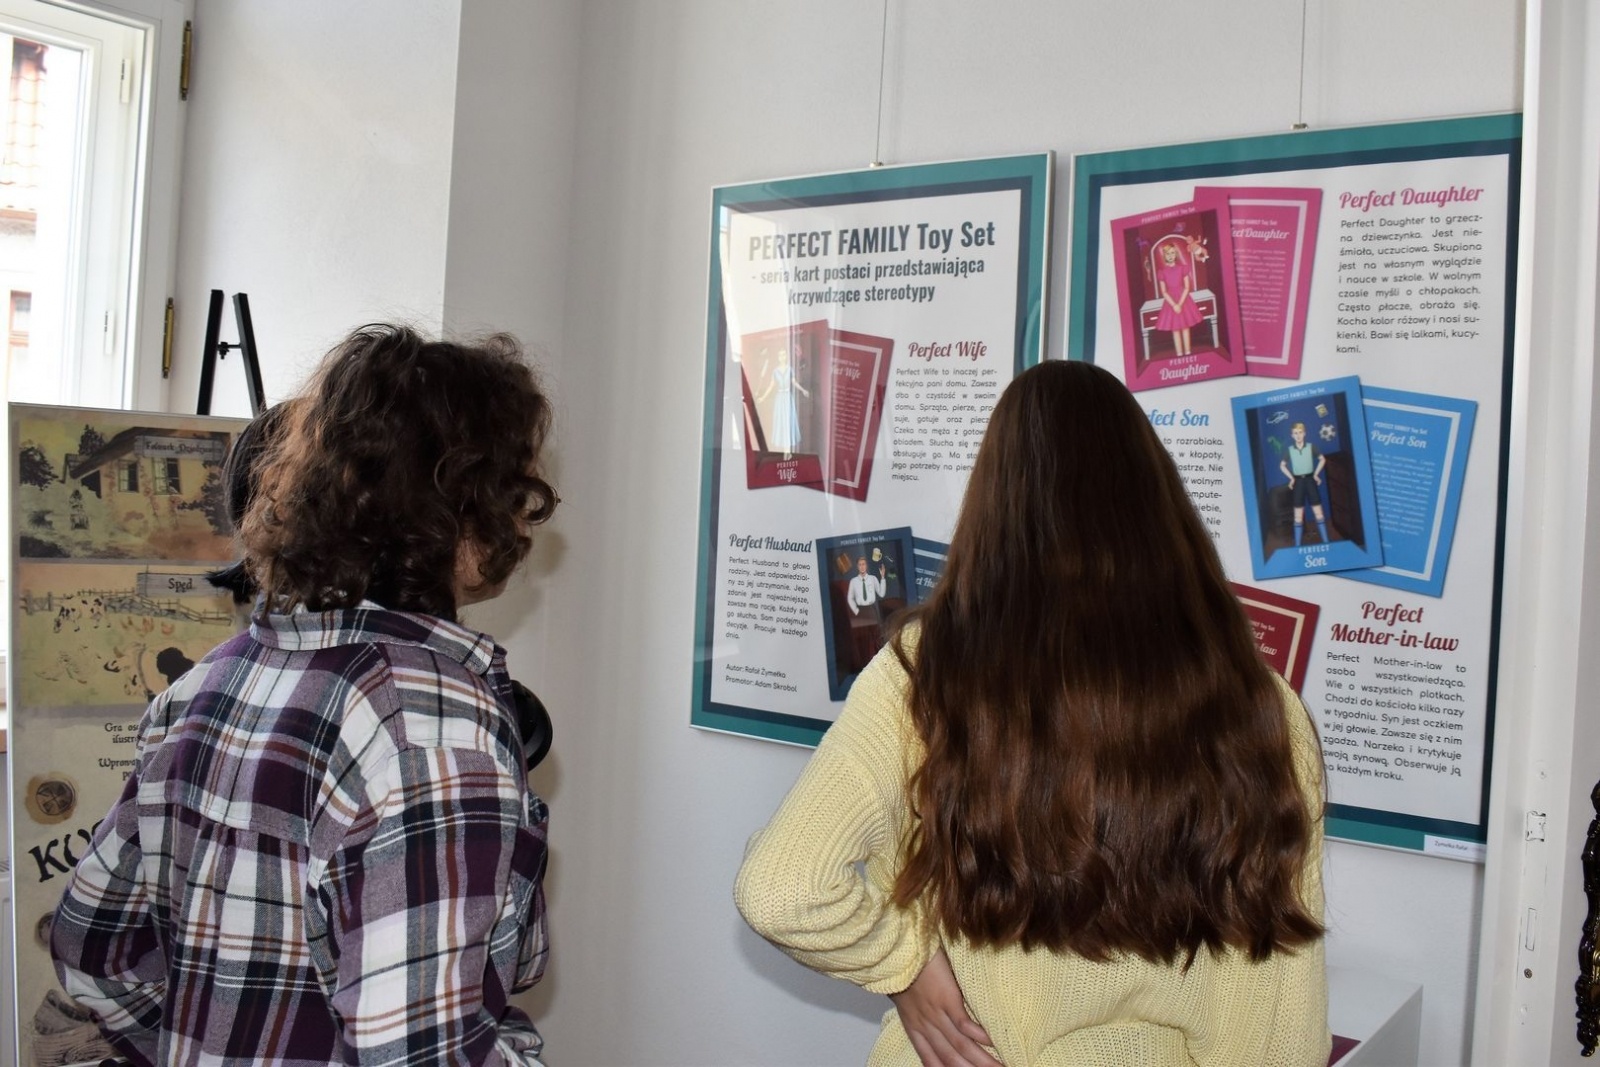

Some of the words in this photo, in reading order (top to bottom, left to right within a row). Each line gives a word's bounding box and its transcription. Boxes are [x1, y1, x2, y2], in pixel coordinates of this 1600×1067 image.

[1340, 191, 1396, 212] Perfect
[1401, 186, 1484, 208] Daughter
[1341, 220, 1374, 228] Perfect
[1379, 217, 1426, 228] Daughter
[1446, 215, 1482, 224] grzecz-
[1245, 227, 1290, 241] Daughter
[1362, 232, 1422, 242] dziewczynka.
[1432, 229, 1453, 238] Jest
[1463, 228, 1482, 237] nie-
[749, 230, 831, 261] PERFECT
[838, 225, 911, 255] FAMILY
[917, 223, 952, 253] Toy
[961, 222, 995, 247] Set
[1340, 247, 1374, 256] śmiała,
[1378, 245, 1429, 255] uczuciowa.
[1433, 242, 1482, 253] Skupiona
[761, 269, 789, 284] seria
[794, 266, 819, 282] kart
[824, 263, 870, 283] postaci
[875, 257, 984, 280] przedstawiająca
[1338, 262, 1356, 272] jest
[1384, 260, 1424, 270] własnym
[1432, 258, 1481, 268] wyglądzie
[1393, 274, 1424, 282] szkole.
[1429, 272, 1439, 280] W
[1443, 272, 1481, 282] wolnym
[789, 287, 860, 307] krzywdzące
[865, 284, 935, 302] stereotypy
[1338, 289, 1369, 298] czasie
[1376, 288, 1399, 298] myśli
[1418, 286, 1480, 296] chłopakach.
[1338, 303, 1370, 313] Często
[1378, 303, 1412, 313] płacze,
[1420, 301, 1455, 310] obraża
[1463, 300, 1480, 310] się.
[1337, 317, 1367, 325] Kocha
[1370, 316, 1395, 325] kolor
[1397, 316, 1430, 325] różowy
[1439, 315, 1460, 323] nosi
[1337, 331, 1366, 339] kienki.
[1370, 331, 1392, 339] Bawi
[1396, 331, 1409, 340] się
[1411, 329, 1448, 339] lalkami,
[1452, 329, 1479, 339] kucy-
[909, 342, 952, 361] Perfect
[956, 341, 987, 361] Wife
[1336, 345, 1361, 353] kami.
[1169, 356, 1198, 366] PERFECT
[953, 368, 978, 377] inaczej
[1159, 364, 1210, 381] Daughter
[927, 380, 942, 388] pani
[926, 392, 956, 401] czystość
[1149, 409, 1176, 426] fect
[1180, 409, 1209, 426] Son
[1176, 438, 1224, 446] rozrabiaka.
[1370, 430, 1406, 446] Perfect
[1407, 436, 1427, 449] Son
[1190, 451, 1224, 460] kłopoty.
[777, 468, 797, 482] Wife
[1209, 464, 1223, 472] Nie
[1191, 477, 1223, 486] wolnym
[1206, 517, 1221, 525] Nie
[729, 534, 763, 551] Perfect
[765, 536, 812, 553] Husband
[1298, 545, 1330, 554] PERFECT
[729, 556, 749, 564] Perfect
[752, 559, 779, 567] Husband
[1304, 555, 1327, 568] Son
[1362, 601, 1424, 627] Perfect
[1330, 623, 1459, 651] Mother-in-law
[1327, 652, 1360, 663] Perfect
[1374, 656, 1443, 671] Mother-in-law
[1456, 664, 1467, 673] to
[755, 680, 772, 688] Adam
[1326, 667, 1356, 676] osoba
[1376, 672, 1465, 688] wszystkowiedząca.
[1325, 679, 1343, 689] Wie
[1361, 684, 1413, 696] wszystkich
[1420, 690, 1464, 702] plotkach.
[1325, 693, 1357, 705] Chodzi
[1360, 698, 1373, 706] do
[1375, 699, 1416, 711] kościoła
[1419, 701, 1440, 714] kilka
[1443, 706, 1465, 717] razy
[1334, 708, 1378, 721] tygodniu.
[1381, 713, 1399, 724] Syn
[1401, 716, 1420, 726] jest
[1423, 720, 1463, 731] oczkiem
[1332, 722, 1344, 732] jej
[1346, 724, 1378, 736] głowie.
[1381, 728, 1416, 740] Zawsze
[1419, 732, 1433, 743] się
[1444, 736, 1463, 745] nim
[1323, 736, 1359, 746] zgadza.
[1364, 740, 1404, 752] Narzeka
[1418, 746, 1462, 761] krytykuje
[1323, 750, 1348, 761] swoją
[1352, 753, 1389, 767] synową.
[1394, 757, 1447, 772] Obserwuje
[1451, 765, 1462, 776] ją
[1337, 764, 1372, 777] każdym
[1374, 768, 1404, 781] kroku.
